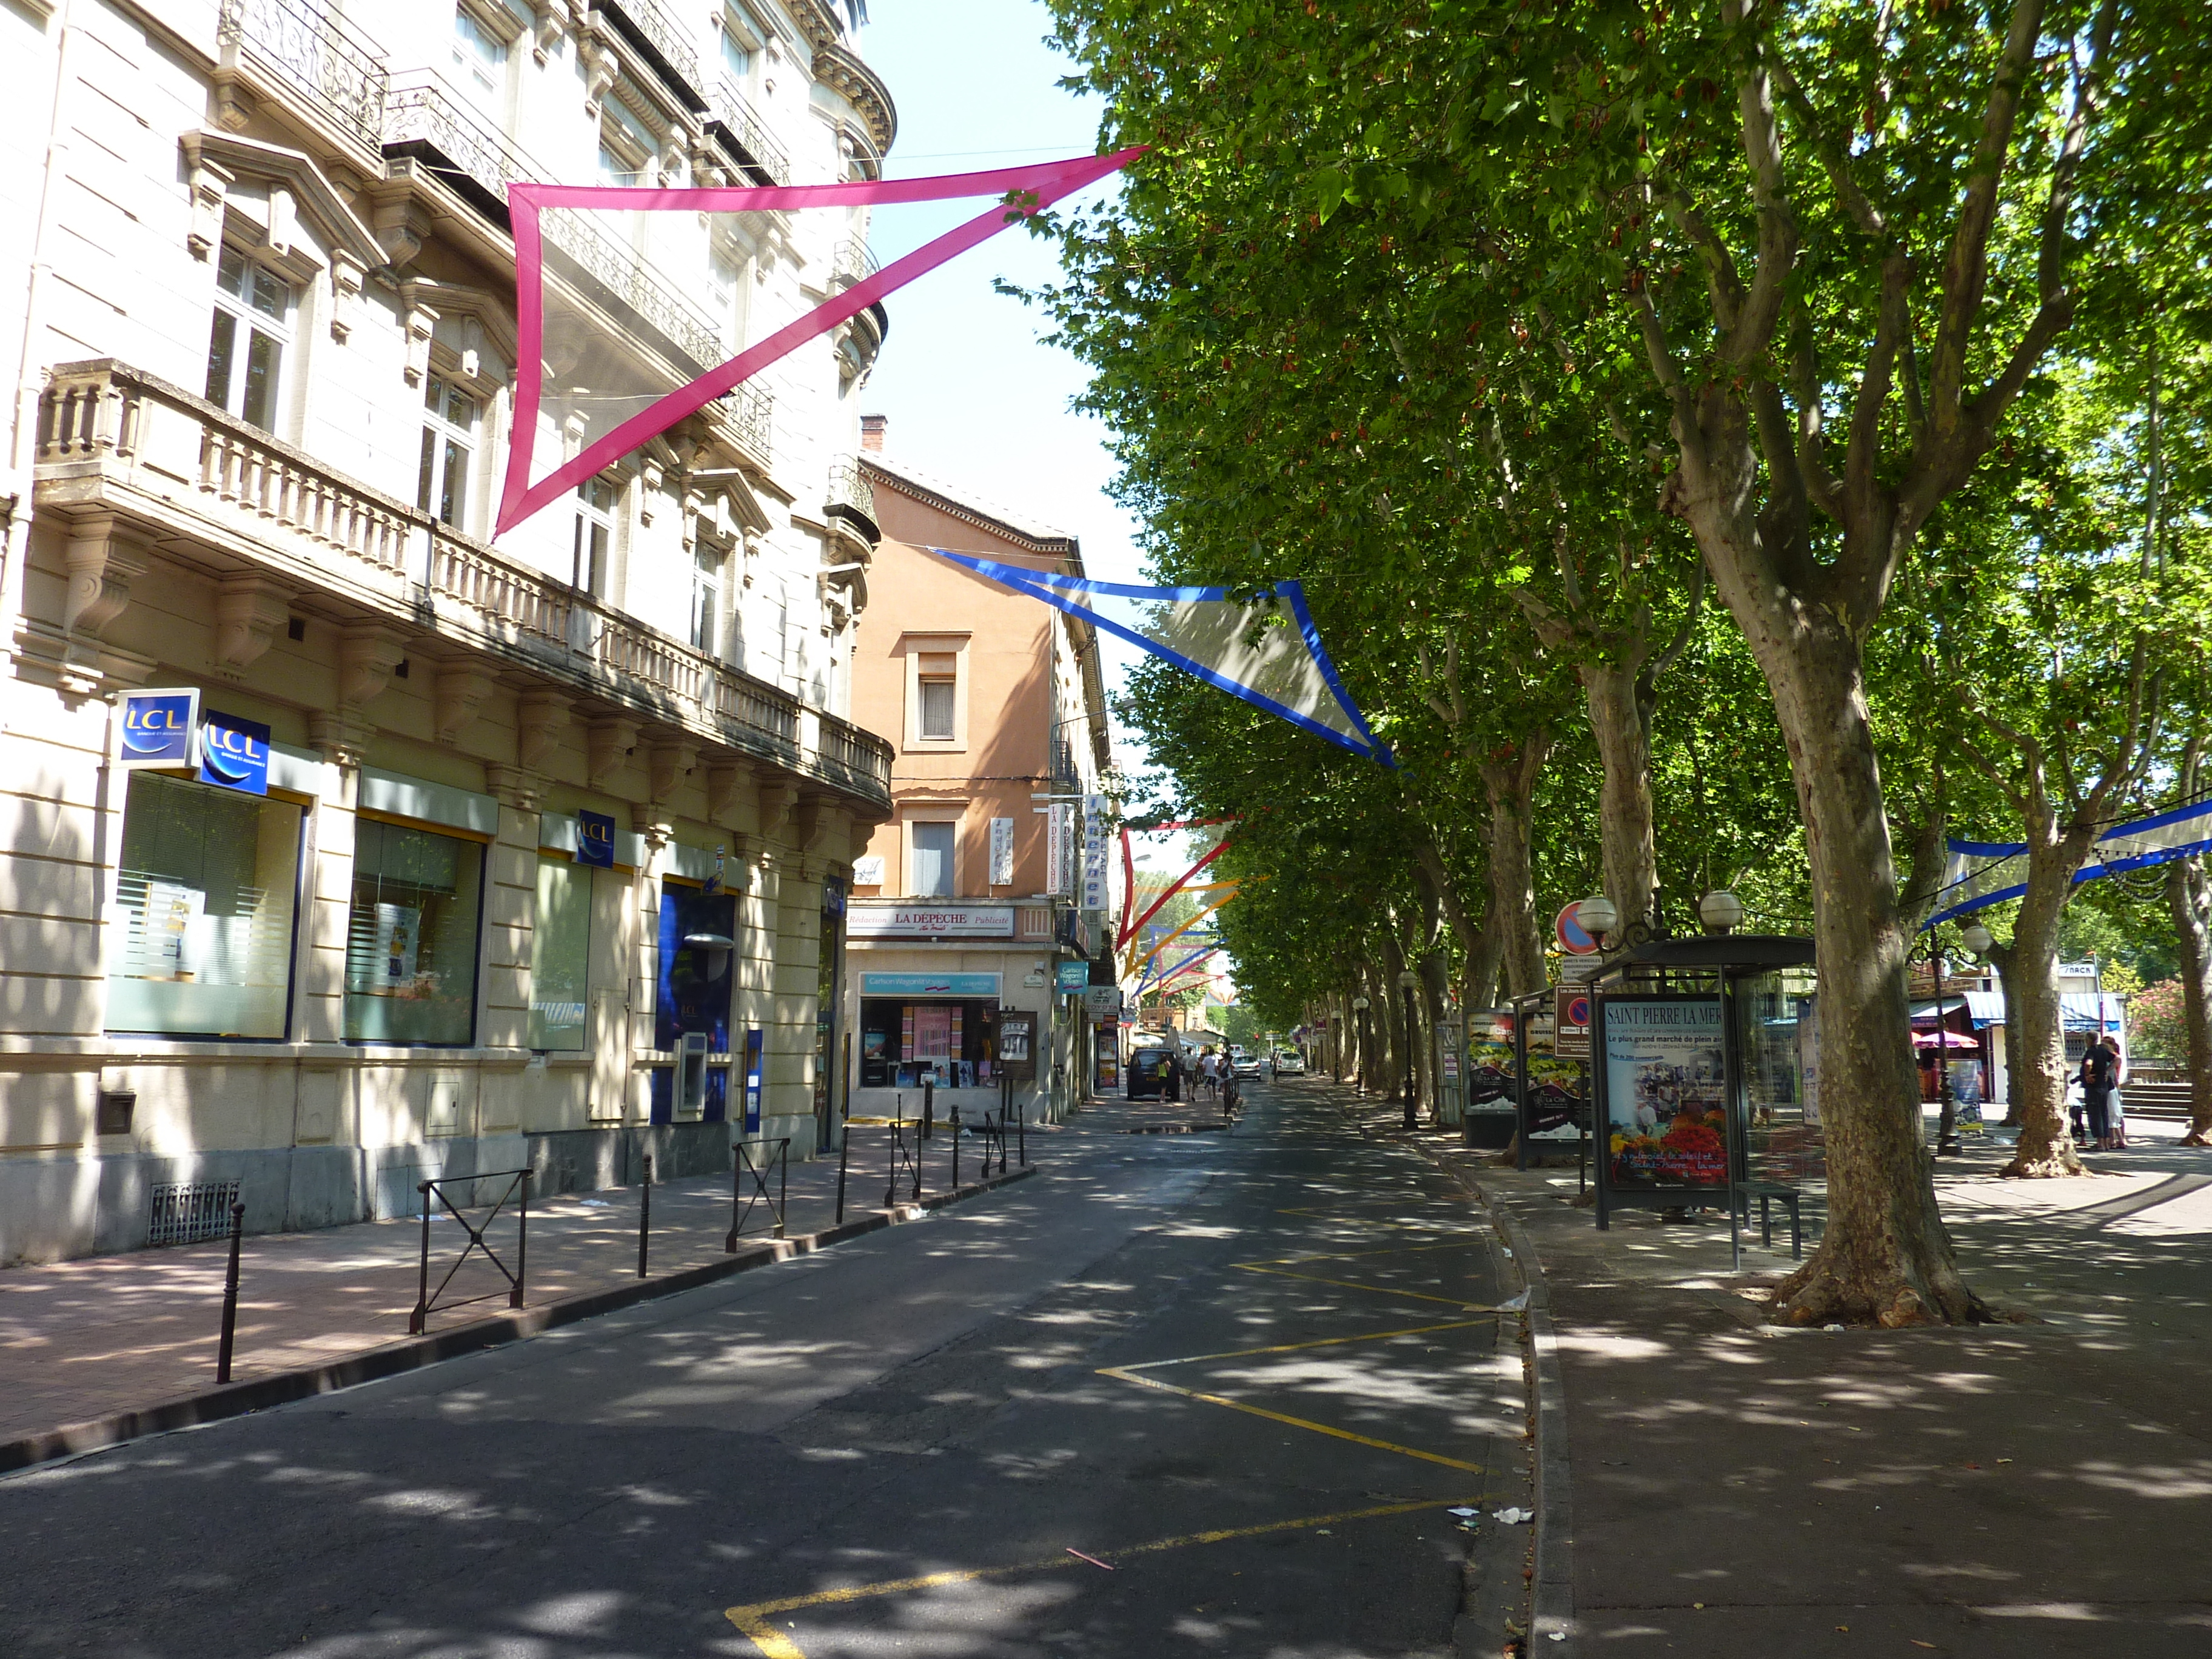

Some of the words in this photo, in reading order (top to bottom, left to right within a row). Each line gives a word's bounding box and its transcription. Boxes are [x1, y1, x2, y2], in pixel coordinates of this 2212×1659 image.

[127, 709, 181, 729] LCL
[209, 724, 261, 759] LCL
[1052, 806, 1057, 823] LA
[1064, 806, 1070, 823] LA
[582, 821, 609, 842] LCL
[1086, 797, 1100, 907] Internet
[895, 914, 911, 923] LA
[925, 978, 950, 987] Voyages
[1608, 1007, 1639, 1024] SAINT
[1643, 1007, 1680, 1024] PIERRE
[1683, 1007, 1697, 1024] LA
[1699, 1007, 1721, 1024] MER
